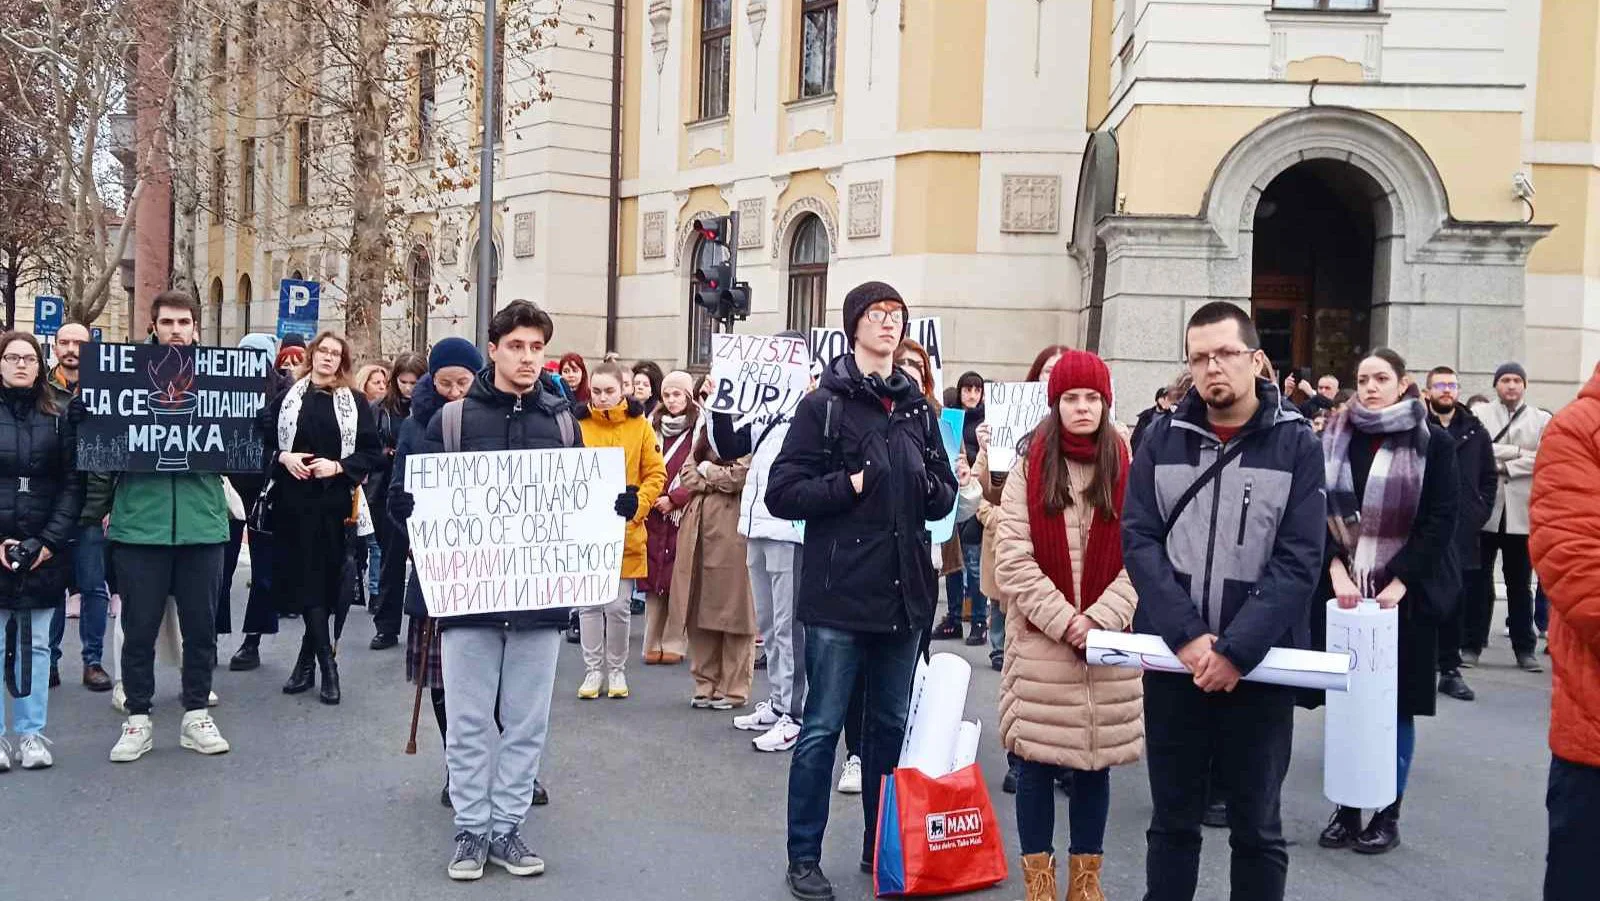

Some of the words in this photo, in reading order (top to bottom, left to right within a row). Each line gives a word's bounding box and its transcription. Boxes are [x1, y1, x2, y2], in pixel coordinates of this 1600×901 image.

[41, 300, 57, 320] P
[289, 285, 310, 315] P
[100, 345, 136, 373] НЕ
[195, 348, 267, 378] ЖЕЛИМ
[737, 361, 782, 386] PRED
[81, 388, 112, 416] ДА
[118, 388, 149, 417] СЕ
[197, 390, 266, 418] ПЛАШИМ
[128, 424, 225, 453] МРАКА
[410, 454, 490, 489] НЕМАМО
[496, 453, 523, 486] МИ
[529, 452, 567, 484] ШТА
[573, 451, 602, 483] ДА
[451, 487, 480, 516] СЕ
[411, 519, 439, 550] МИ
[444, 517, 483, 547] СМО
[489, 514, 516, 545] СЕ
[521, 511, 575, 544] ОВДЕ
[431, 579, 507, 614] ШИРИТИ
[515, 578, 529, 607] И
[536, 574, 611, 606] ШИРИТИ
[947, 813, 980, 834] MAXI
